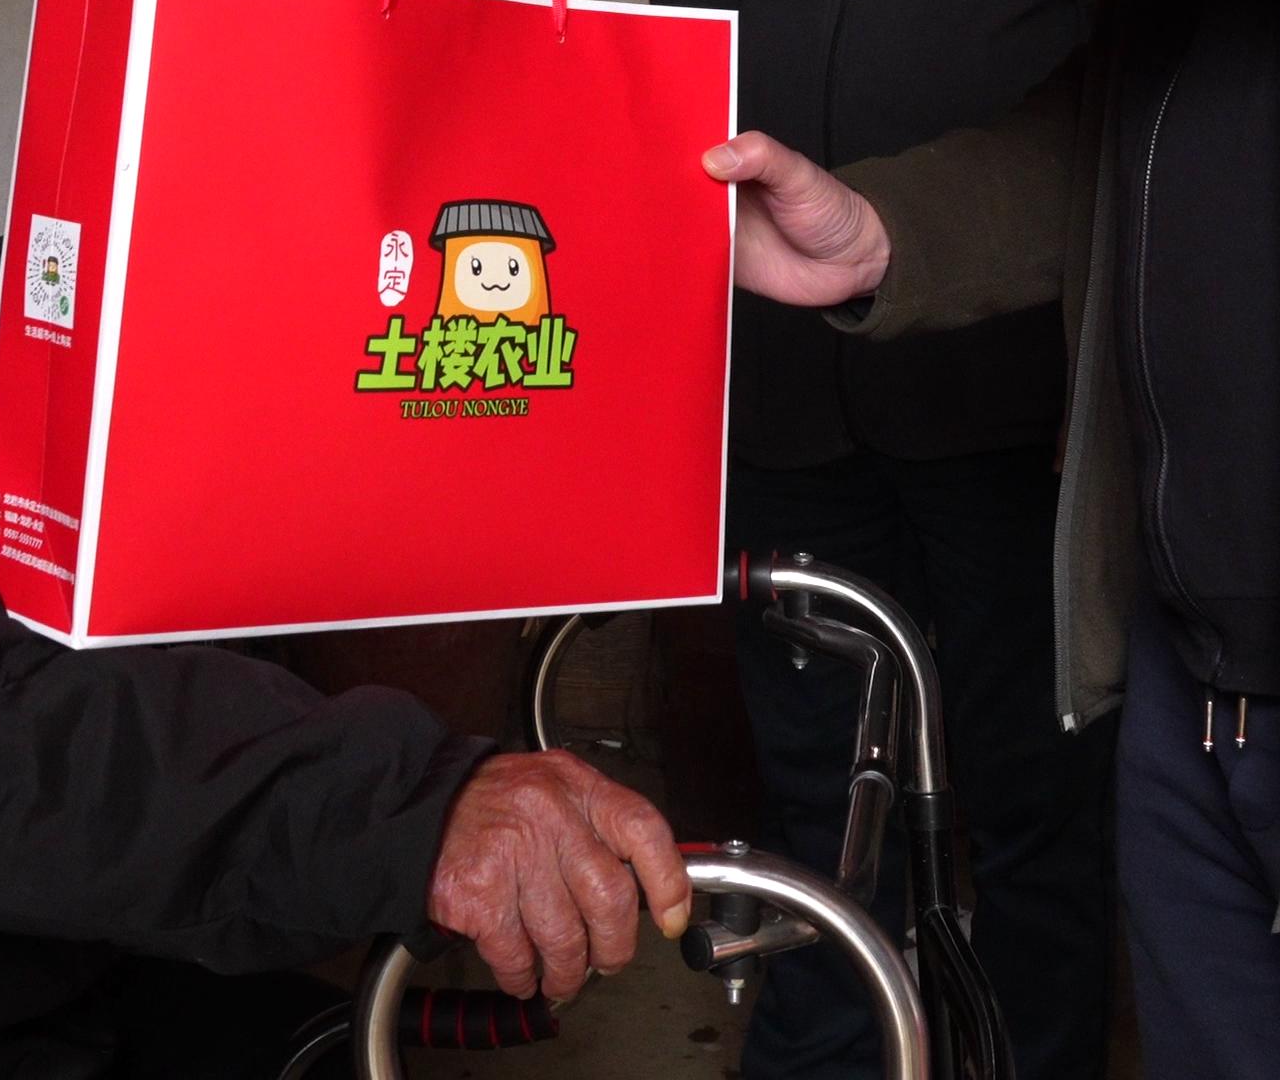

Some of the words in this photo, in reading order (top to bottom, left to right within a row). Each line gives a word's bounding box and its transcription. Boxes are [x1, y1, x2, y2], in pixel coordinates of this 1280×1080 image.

[379, 233, 409, 296] 永定
[355, 314, 578, 393] 土楼农业
[401, 400, 458, 419] TULOU
[462, 398, 529, 417] NONGYE
